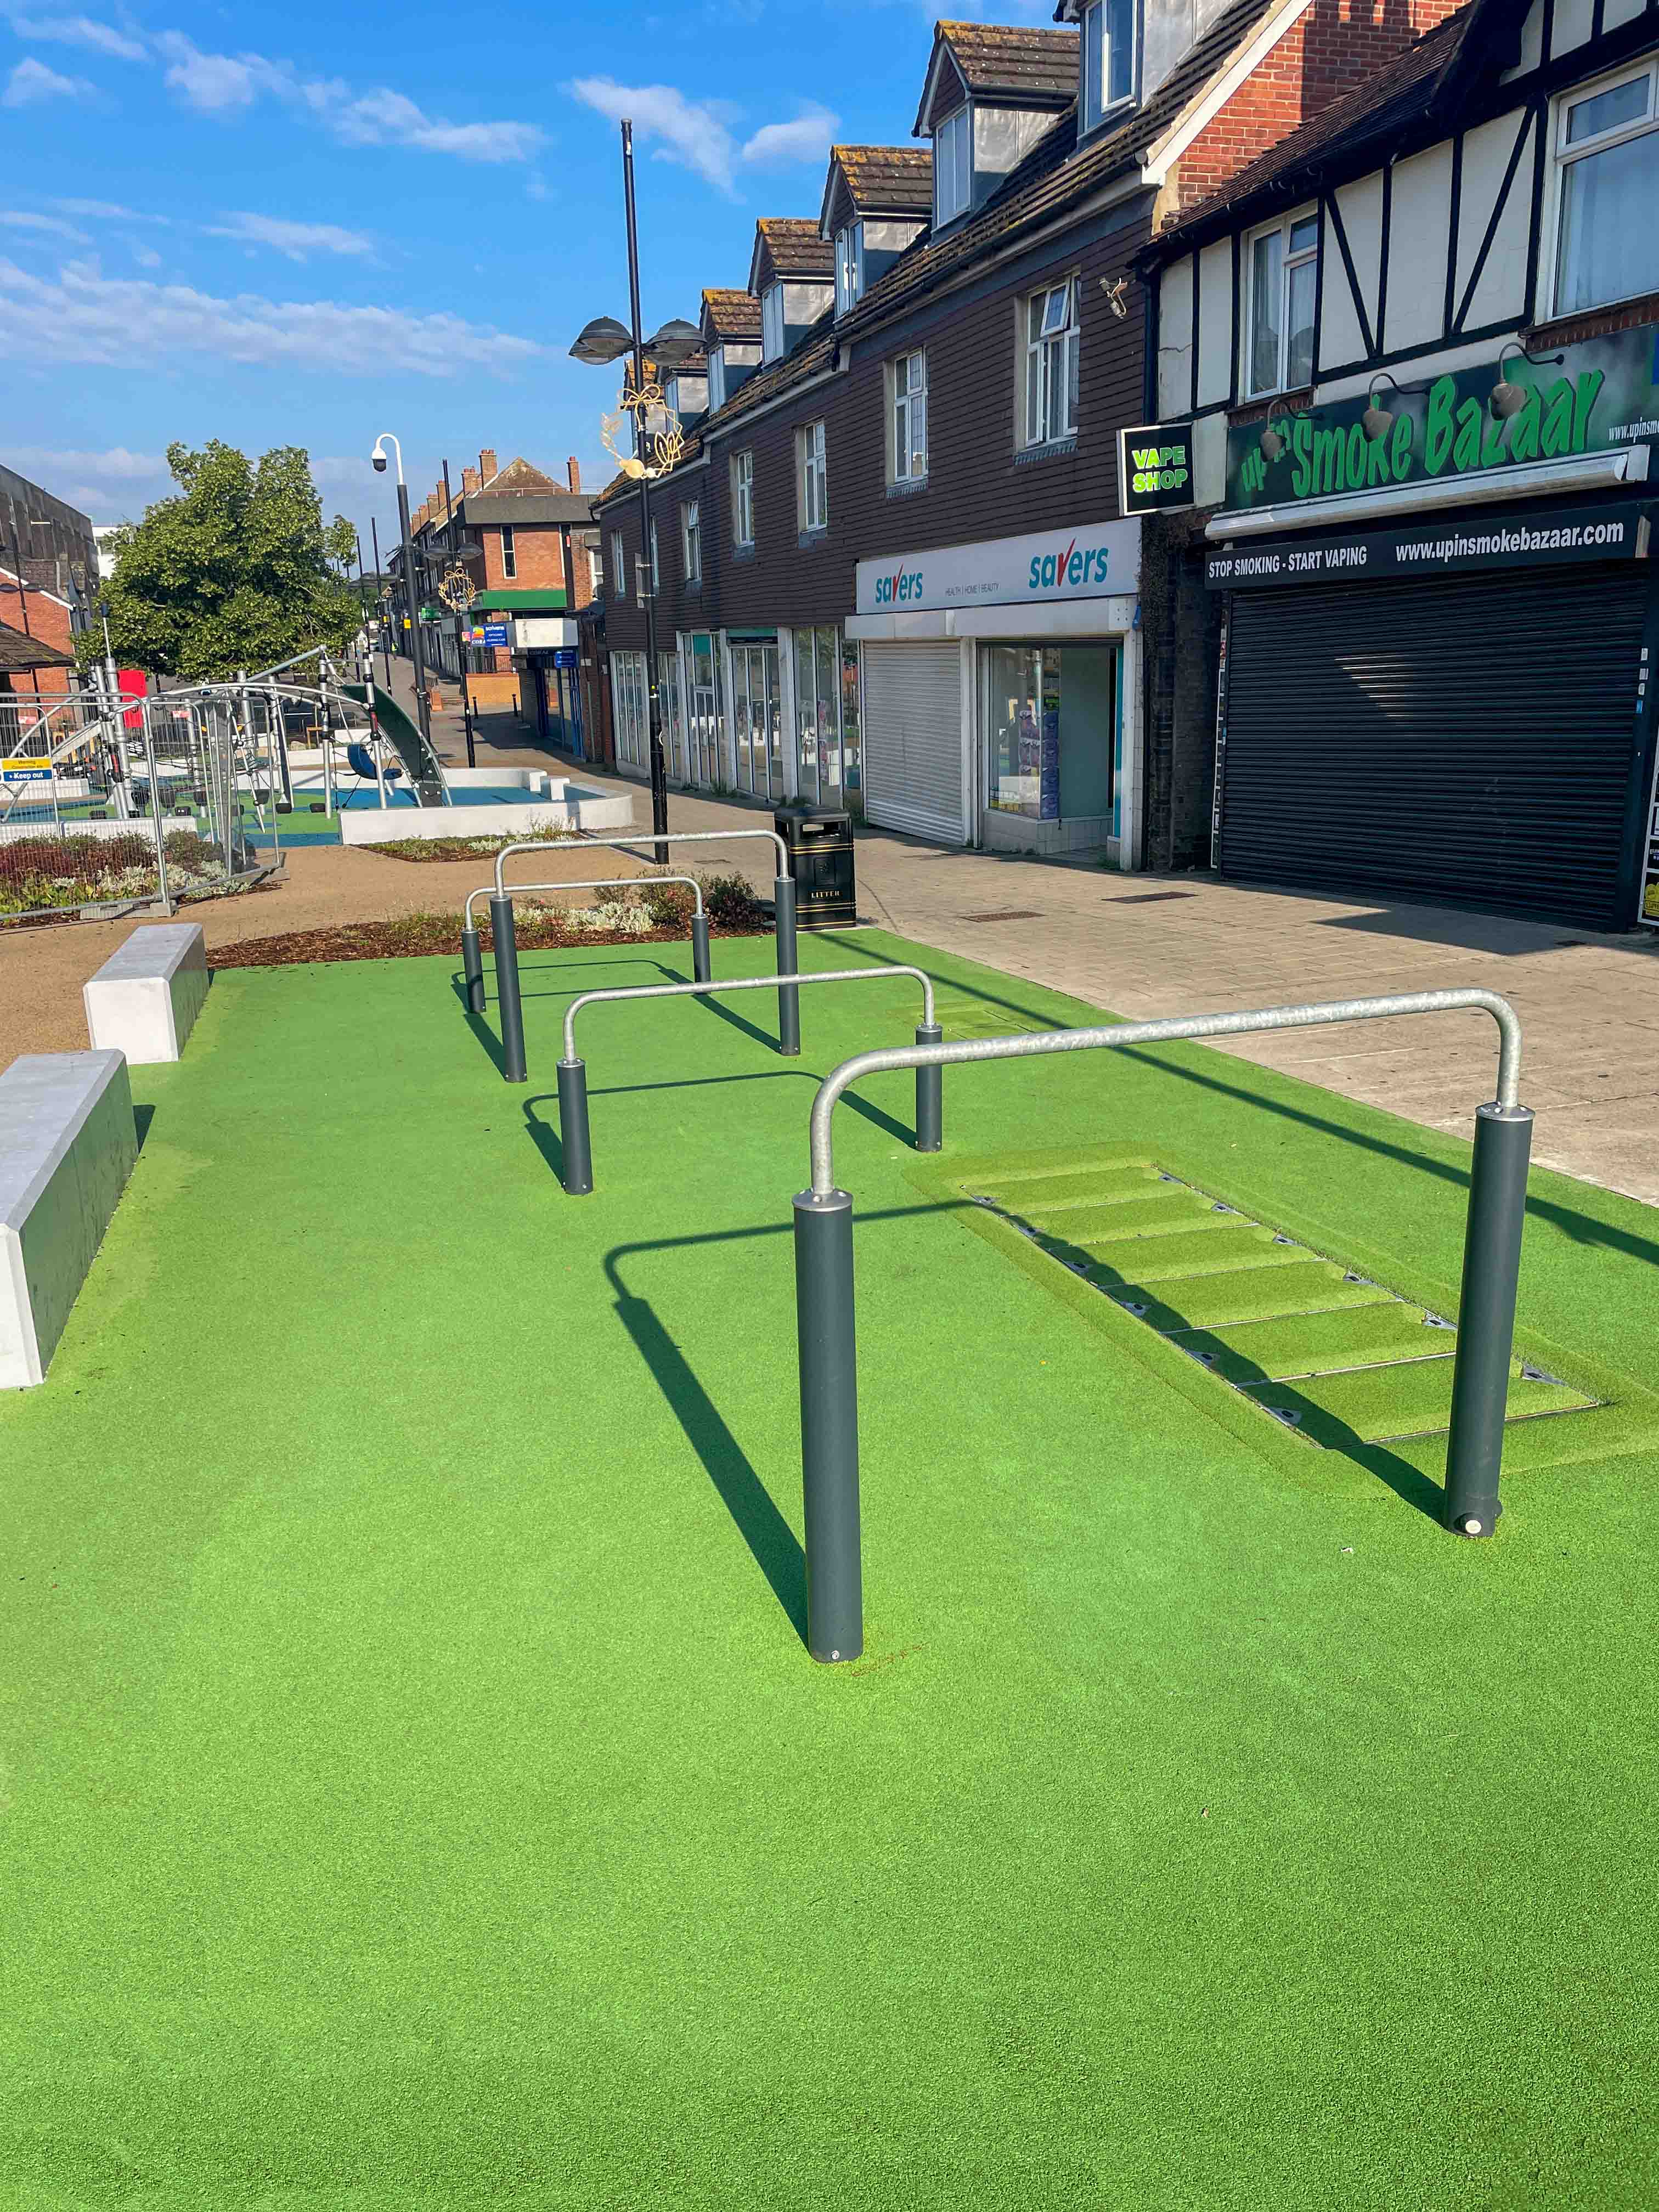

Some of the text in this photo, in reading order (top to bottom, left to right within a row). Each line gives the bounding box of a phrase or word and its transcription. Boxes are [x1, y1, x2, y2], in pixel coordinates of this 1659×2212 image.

[1132, 445, 1186, 470] VAPE
[1291, 393, 1414, 497] Smoke
[1133, 469, 1188, 493] SHOP
[1396, 523, 1624, 563] www.upinsmokebazaar.com
[1029, 538, 1109, 588] savers
[1209, 560, 1232, 578] STOP
[1234, 555, 1280, 575] SMOKING
[1289, 551, 1322, 571] START
[1325, 546, 1367, 567] VAPING
[875, 563, 923, 603] savers
[964, 584, 978, 595] HOME
[981, 583, 999, 593] BEAUTY
